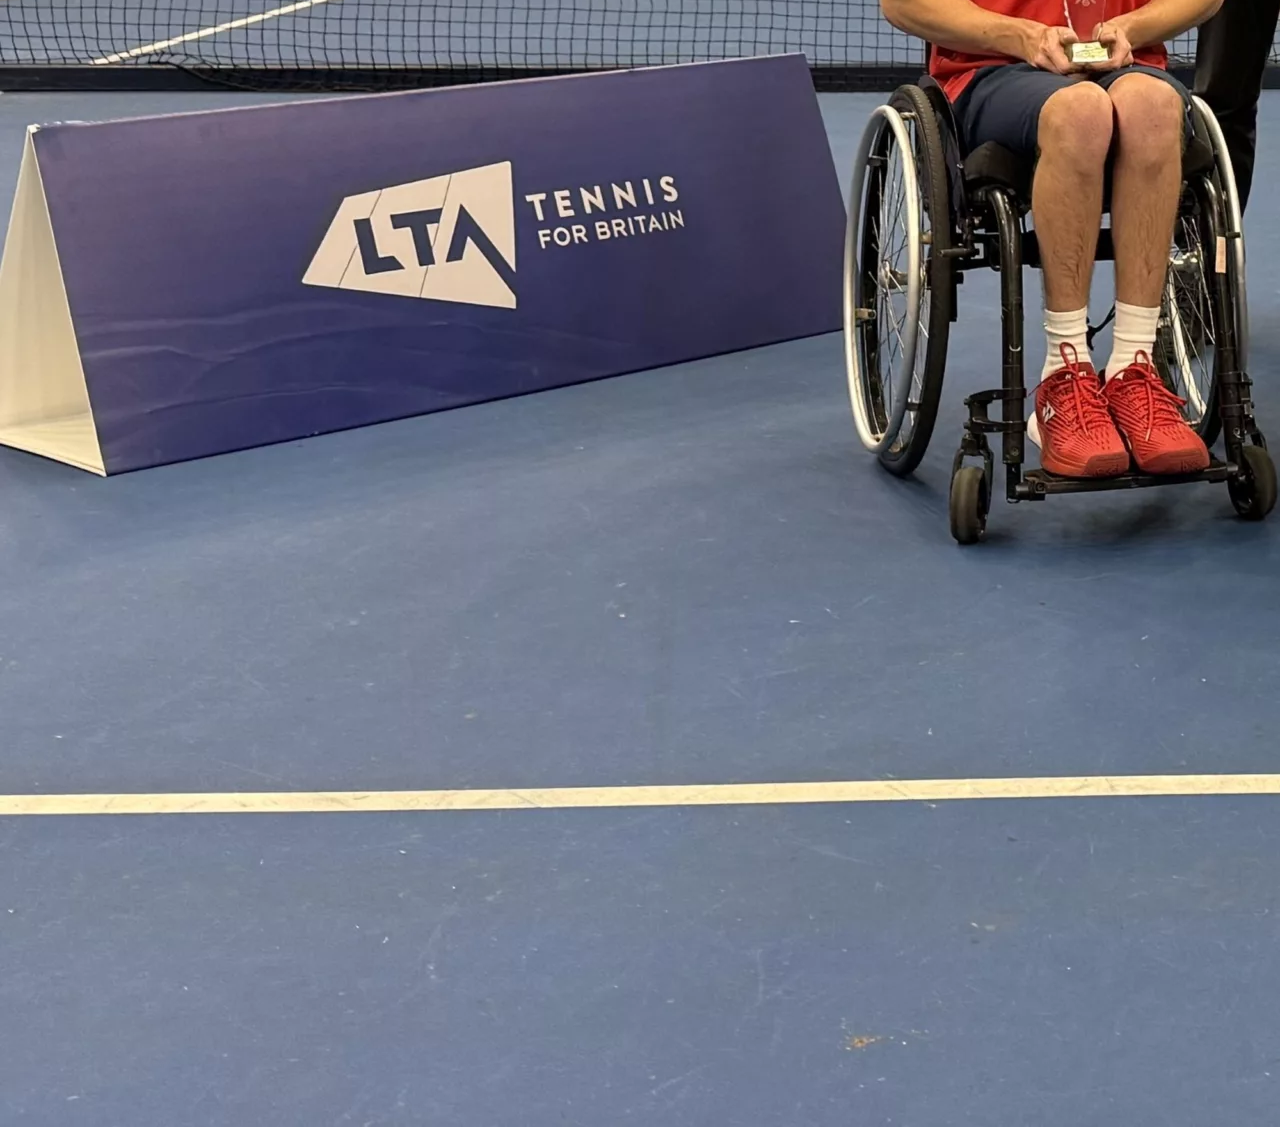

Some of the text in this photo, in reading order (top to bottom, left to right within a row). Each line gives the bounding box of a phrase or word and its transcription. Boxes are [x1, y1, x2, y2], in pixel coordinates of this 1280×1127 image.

[525, 175, 680, 222] TENNIS
[352, 202, 516, 288] LTA
[537, 210, 685, 249] FOR BRITAIN
